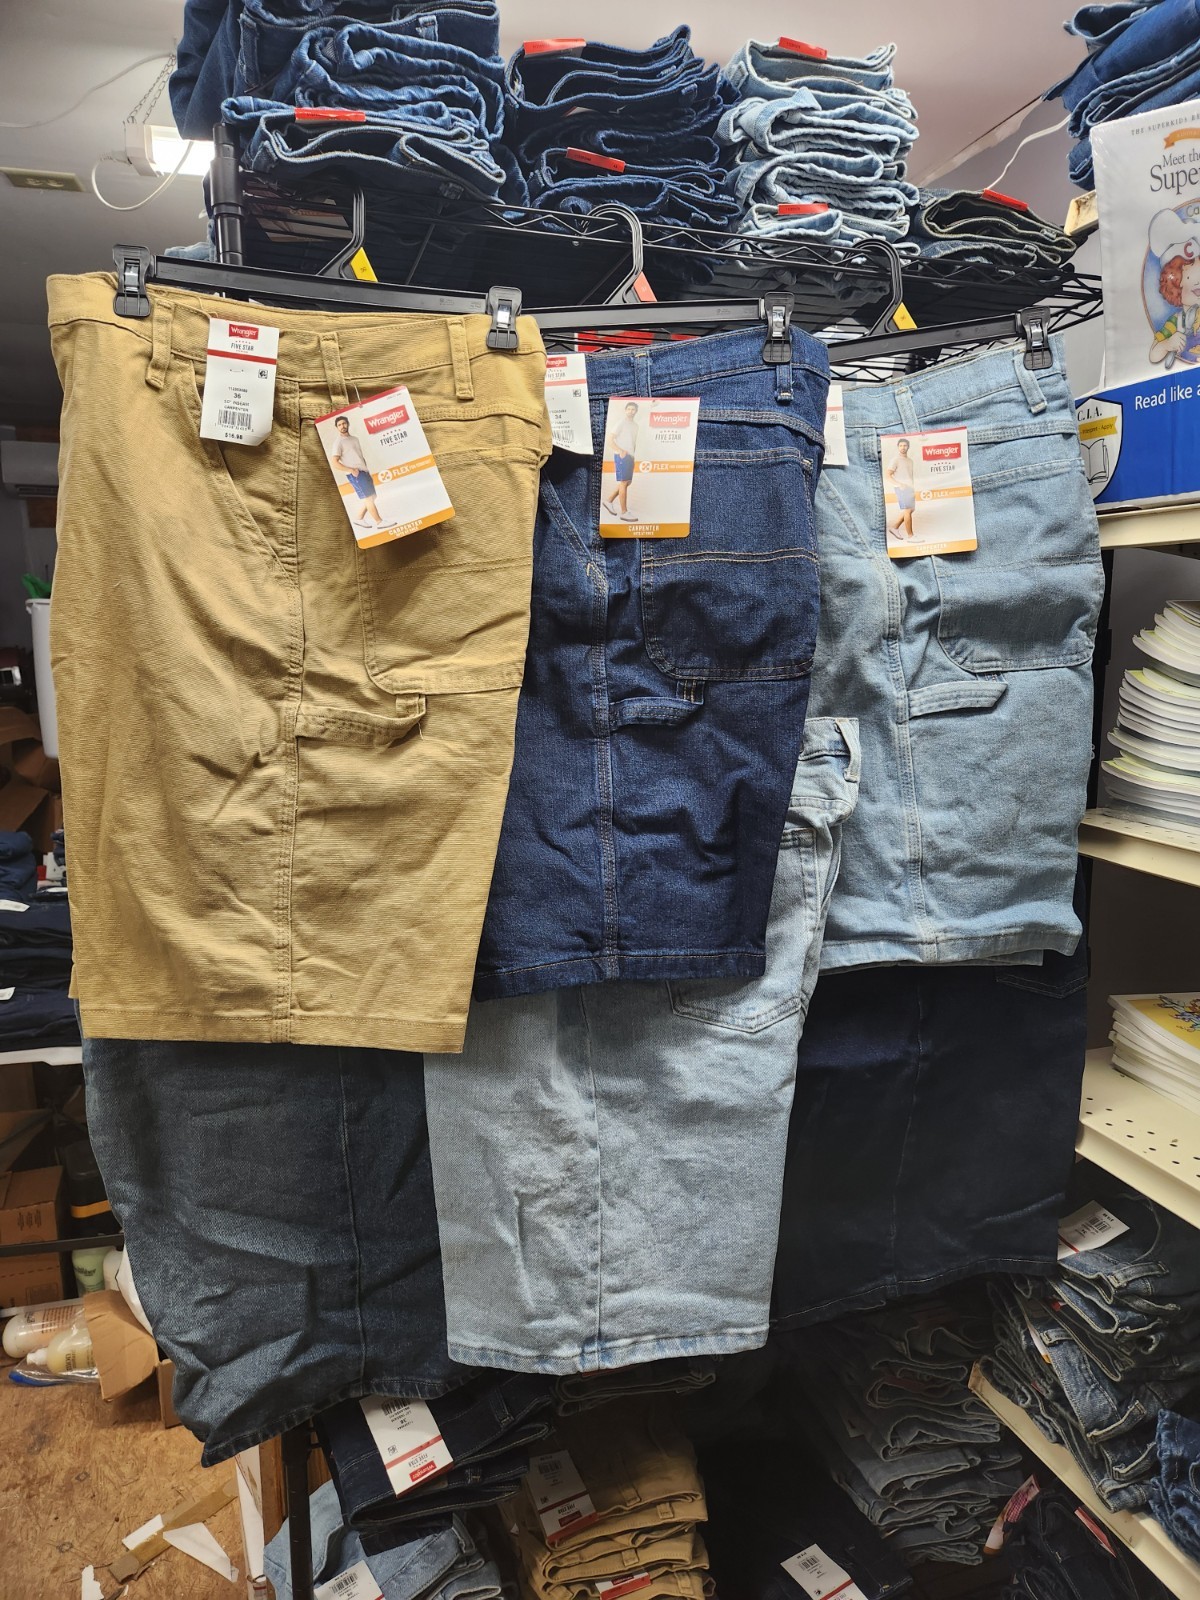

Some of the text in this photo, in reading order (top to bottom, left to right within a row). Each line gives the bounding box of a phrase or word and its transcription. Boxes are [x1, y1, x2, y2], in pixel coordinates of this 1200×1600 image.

[1163, 153, 1186, 168] Meet
[1150, 164, 1200, 196] Supe
[230, 326, 258, 338] Wrangler
[231, 342, 241, 350] FIVE
[1134, 388, 1166, 411] Read
[1170, 384, 1192, 403] like
[367, 409, 405, 428] Wrangler
[652, 414, 688, 425] Wrangler
[1077, 406, 1103, 422] C.I.A.
[380, 430, 408, 446] FIVE STAR
[655, 433, 682, 441] FIVE STAR
[925, 446, 959, 458] Wrangler
[392, 466, 410, 477] FLEX
[930, 464, 956, 473] FIVE STAR
[388, 519, 423, 536] CARPENTER
[412, 1463, 436, 1479] Wrangler
